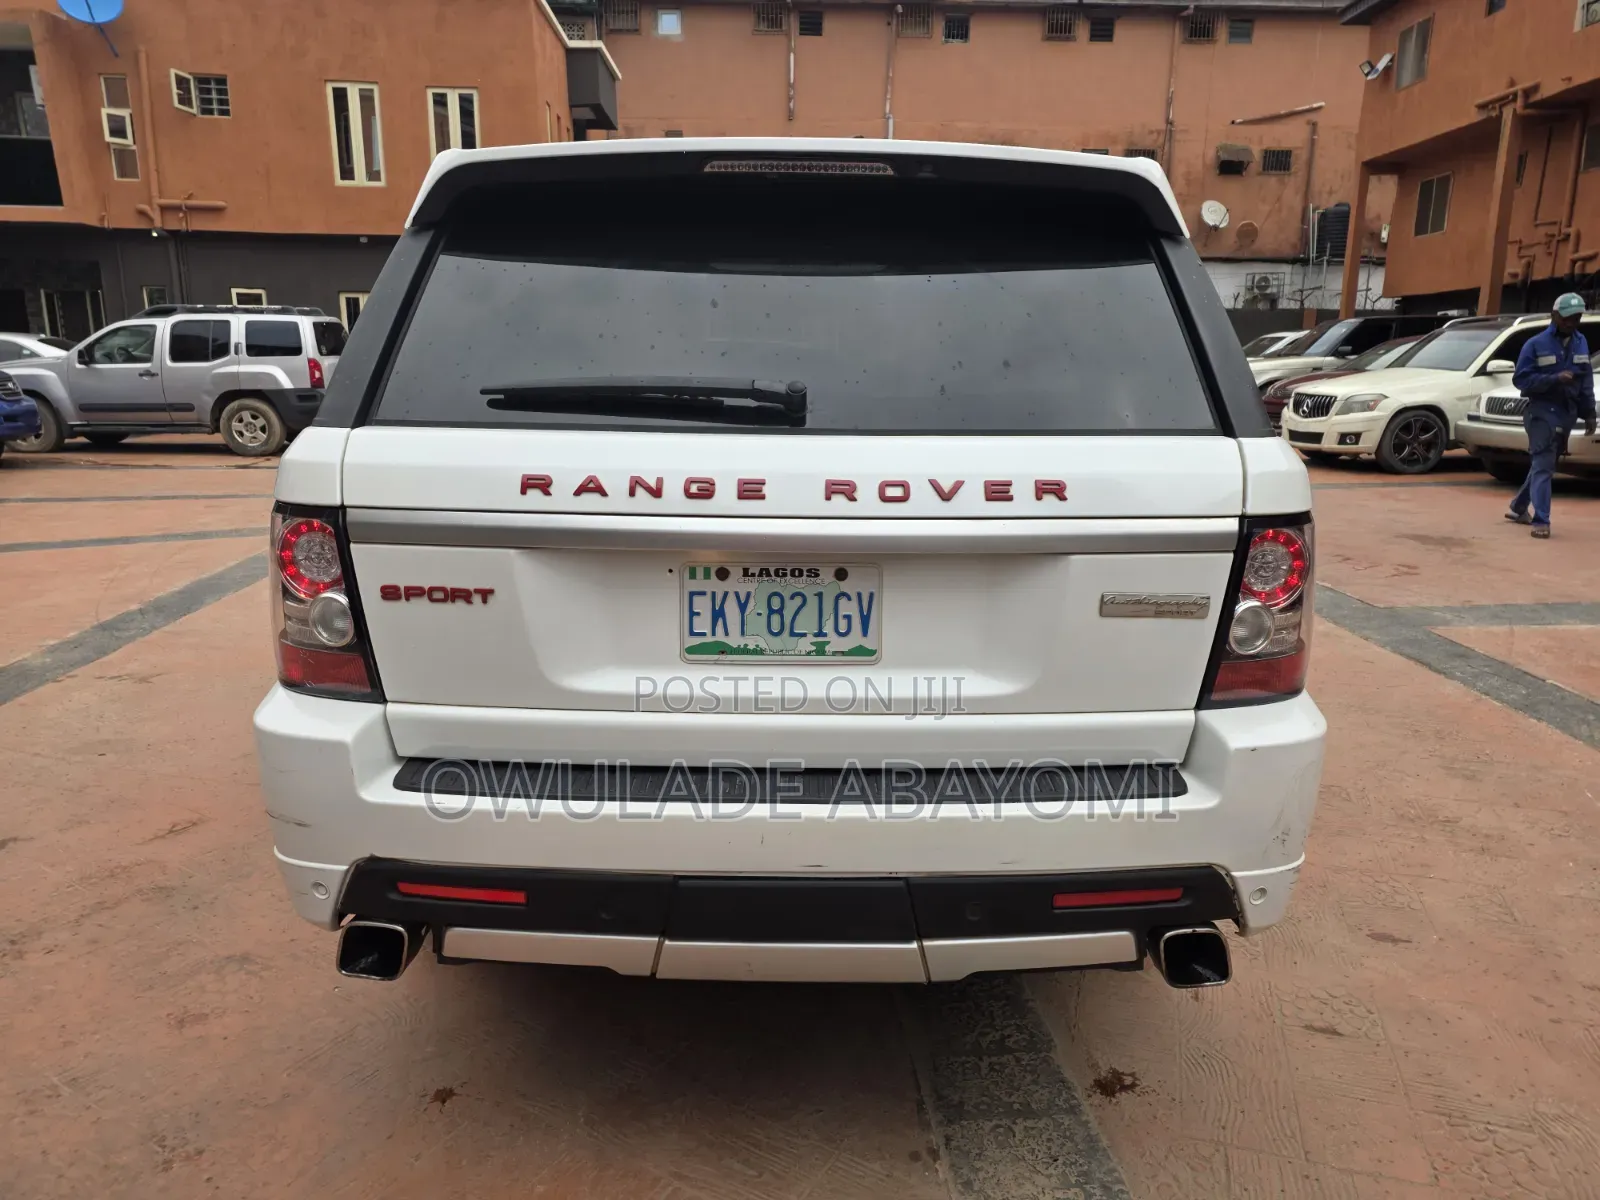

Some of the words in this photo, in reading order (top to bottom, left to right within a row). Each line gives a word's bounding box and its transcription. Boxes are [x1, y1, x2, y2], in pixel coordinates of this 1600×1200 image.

[520, 473, 766, 500] RANGE
[824, 478, 1068, 503] ROVER
[741, 567, 821, 578] LAGOS
[766, 577, 777, 585] OF
[779, 577, 826, 585] EXCELLENCE
[379, 584, 495, 605] SPORT
